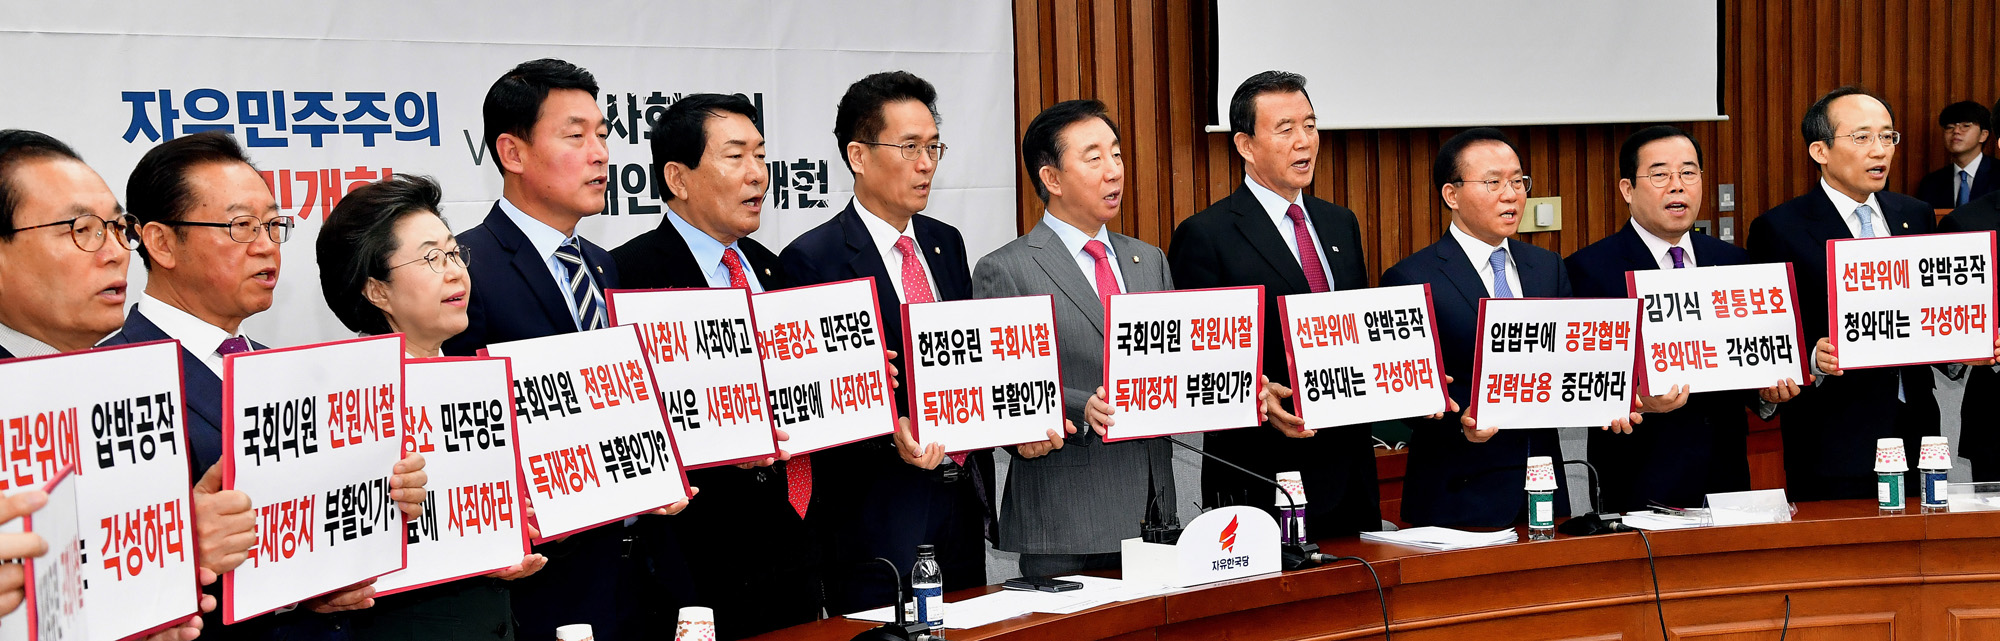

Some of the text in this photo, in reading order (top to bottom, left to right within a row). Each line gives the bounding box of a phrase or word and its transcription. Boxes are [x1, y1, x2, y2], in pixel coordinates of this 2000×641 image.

[121, 88, 441, 148] 자유민주주의
[1842, 254, 1986, 292] 선관위에 압박공작
[1644, 286, 1787, 323] 김기식 철통보호
[1844, 303, 1987, 343] 청와대는 각성하라
[643, 318, 753, 364] 사참사 사죄하고
[757, 310, 876, 361] BH출장소 민주당은
[917, 322, 1051, 368] 헌정유린 국회사찰
[1116, 315, 1253, 357] 국회의원 전원사찰
[1296, 307, 1426, 349] 선관위에 압박공작
[1490, 320, 1631, 353] 입법부에 공갈협박
[1651, 334, 1793, 373] 청와대는 각성하라
[579, 359, 650, 410] 전원사찰
[768, 369, 884, 428] 국민앞에 사죄하라
[1115, 370, 1253, 413] 독재정치 부활인가?
[1303, 357, 1434, 402] 청와대는 각성하라
[1487, 370, 1627, 404] 권력남용 중단하라
[243, 383, 396, 467] 국회의원 전원사찰
[440, 399, 506, 453] 민주당은
[706, 382, 764, 427] 사퇴하라
[923, 379, 1056, 427] 독재정치 부활인가?
[91, 391, 177, 470] 압박공작
[528, 429, 669, 499] 독재정치 부활인가?
[448, 479, 514, 537] 사죄하라
[100, 498, 185, 582] 각성하라
[1212, 555, 1250, 571] 자유한국당
